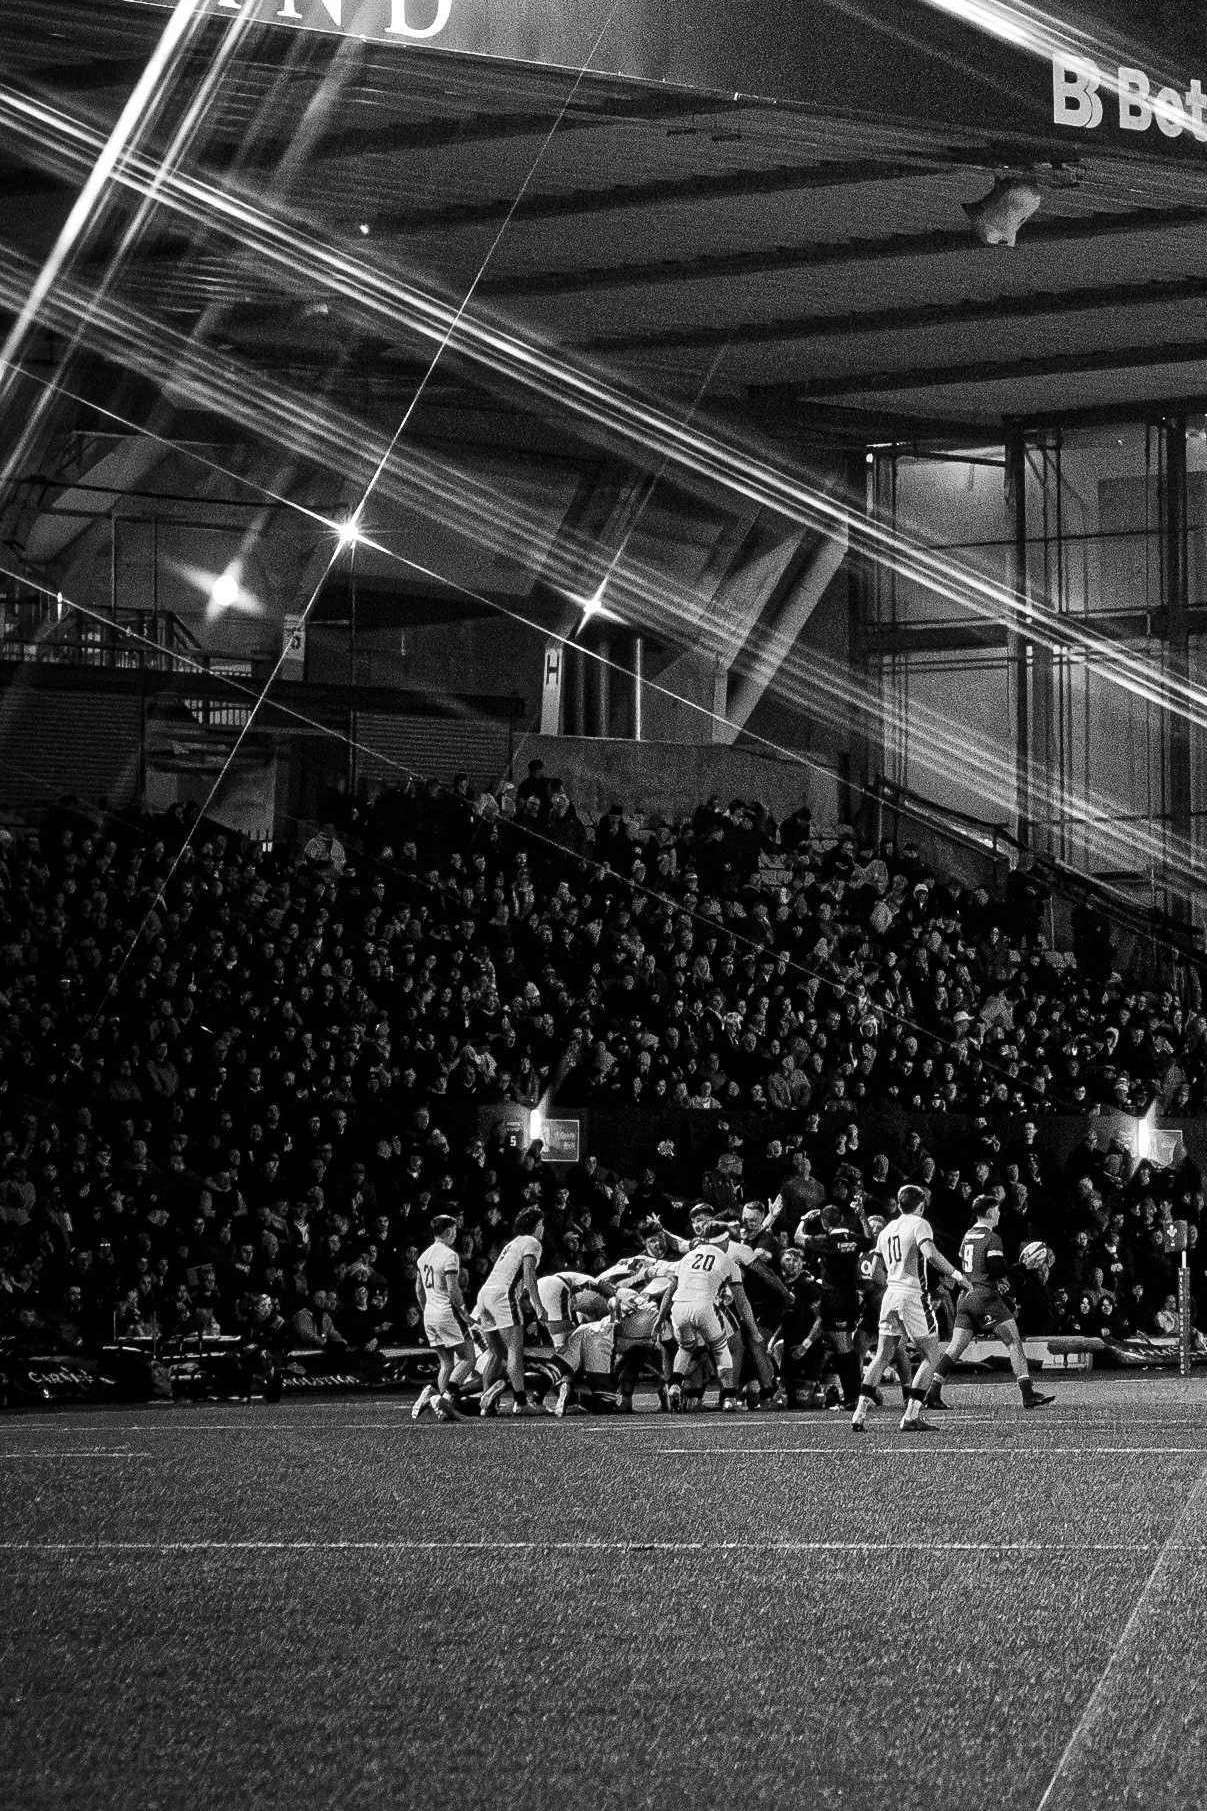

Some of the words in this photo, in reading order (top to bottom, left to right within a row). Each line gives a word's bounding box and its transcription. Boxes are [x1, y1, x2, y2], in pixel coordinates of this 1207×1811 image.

[546, 653, 560, 685] H
[692, 1252, 716, 1272] 20
[887, 1234, 902, 1264] 10
